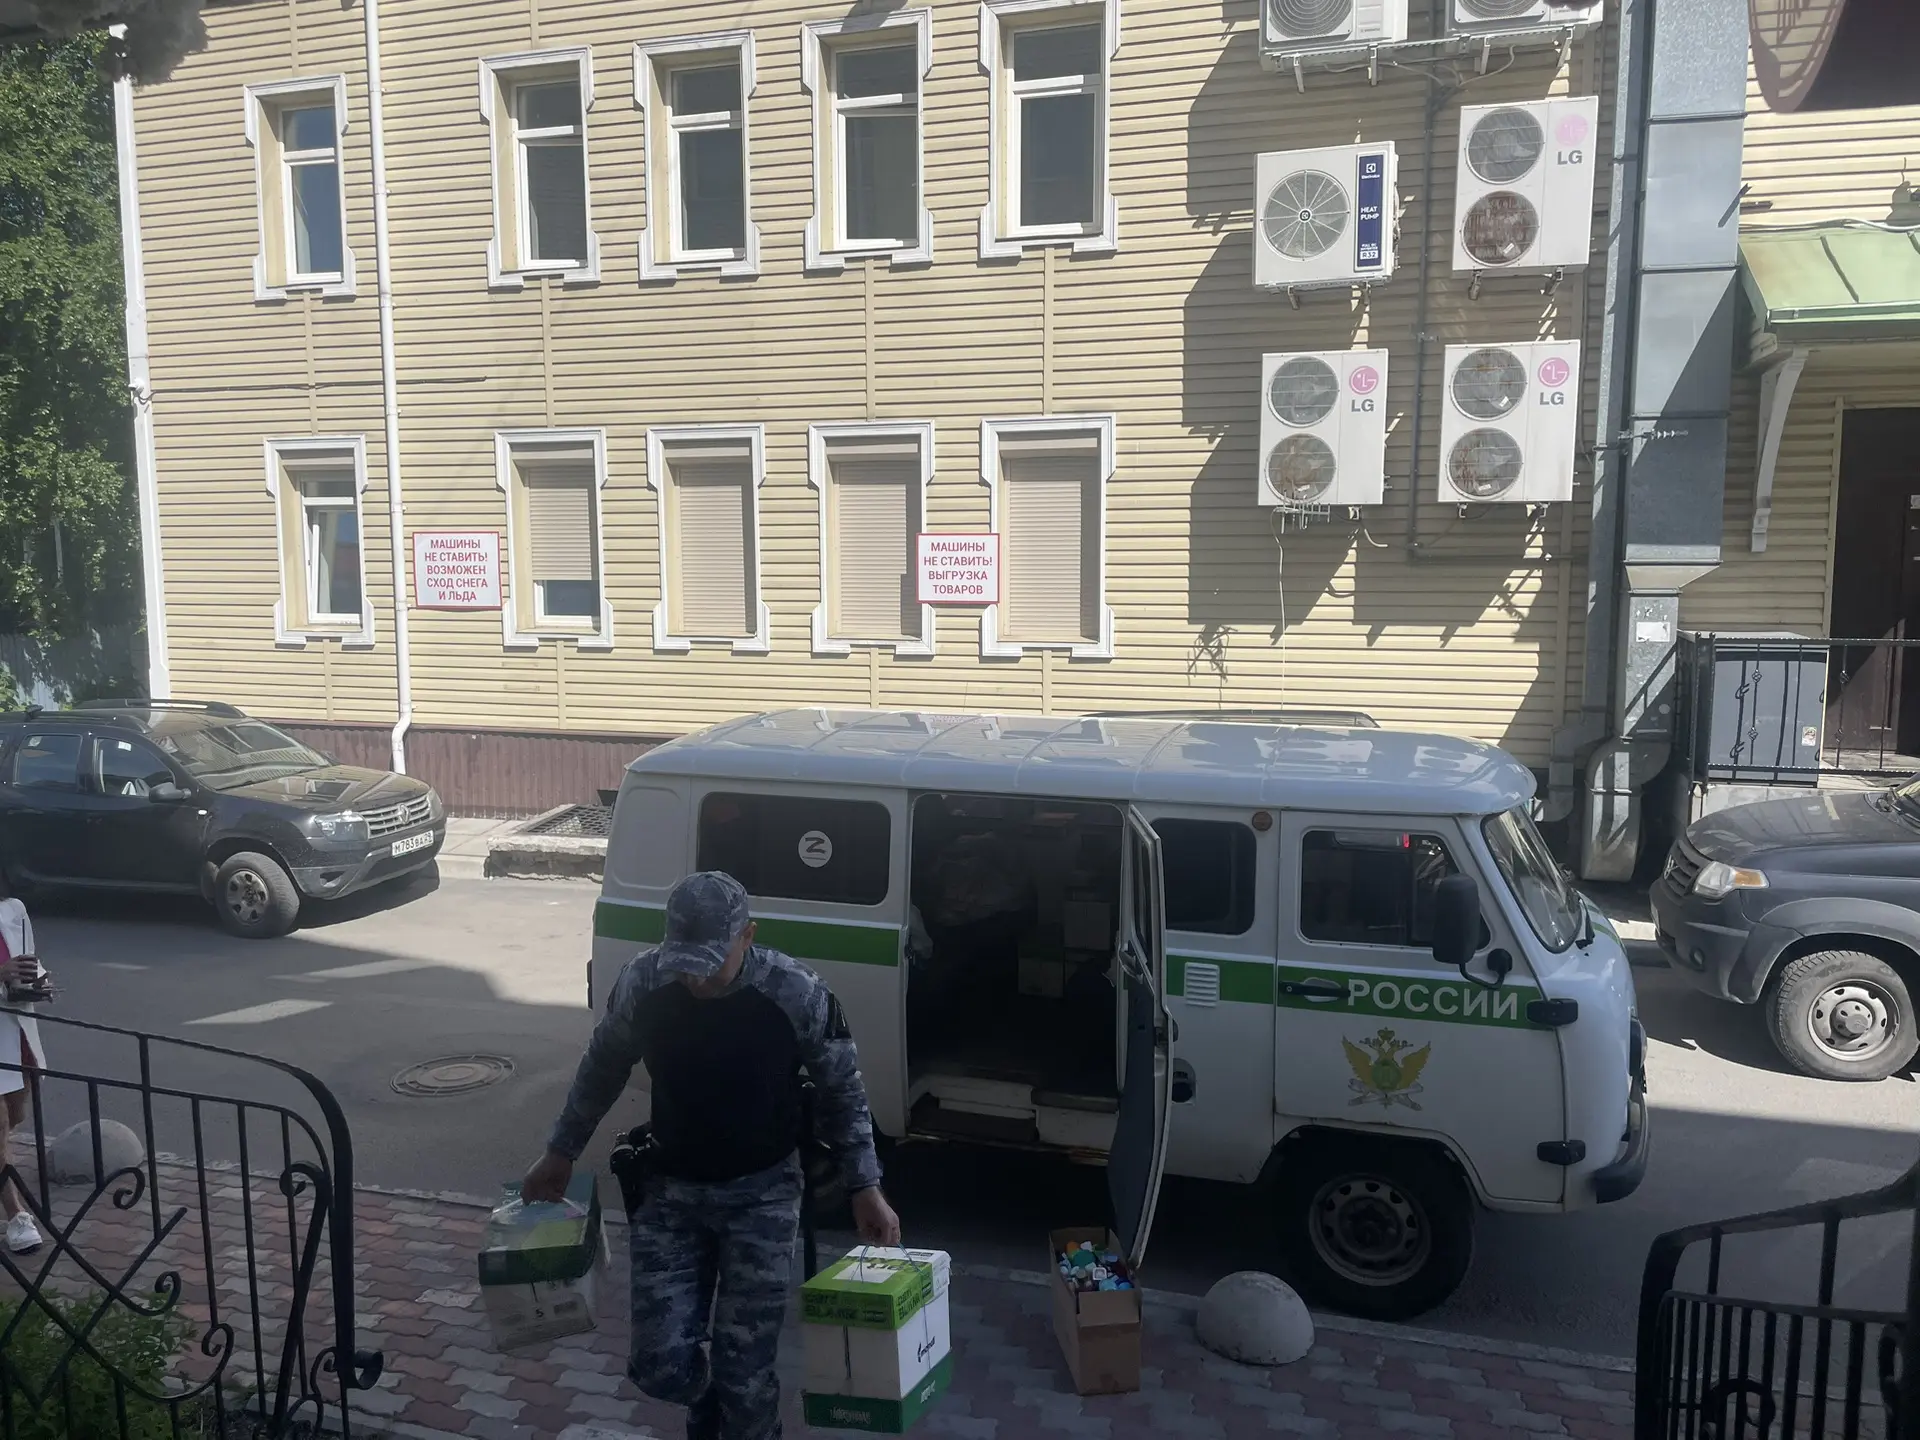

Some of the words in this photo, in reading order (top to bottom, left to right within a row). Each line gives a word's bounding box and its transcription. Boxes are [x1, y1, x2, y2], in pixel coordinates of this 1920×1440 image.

[1557, 150, 1583, 165] LG
[1540, 391, 1564, 405] LG
[1351, 399, 1375, 412] LG
[430, 539, 481, 549] МАШИНЫ
[930, 542, 985, 552] МАШИНЫ
[424, 552, 437, 562] НЕ
[439, 552, 488, 562] СТАВИТЬ!
[923, 556, 938, 566] НЕ
[940, 556, 992, 566] СТАВИТЬ!
[427, 565, 486, 575] ВОЗМОЖЕН
[928, 570, 988, 580] ВЫГРУЗКА
[426, 578, 454, 589] СХОД
[455, 578, 488, 588] СНЕГА
[932, 585, 984, 594] ТОВАРОВ
[439, 591, 446, 600] И
[448, 591, 477, 602] ЛЬДА
[1347, 978, 1518, 1020] РОССИИ
